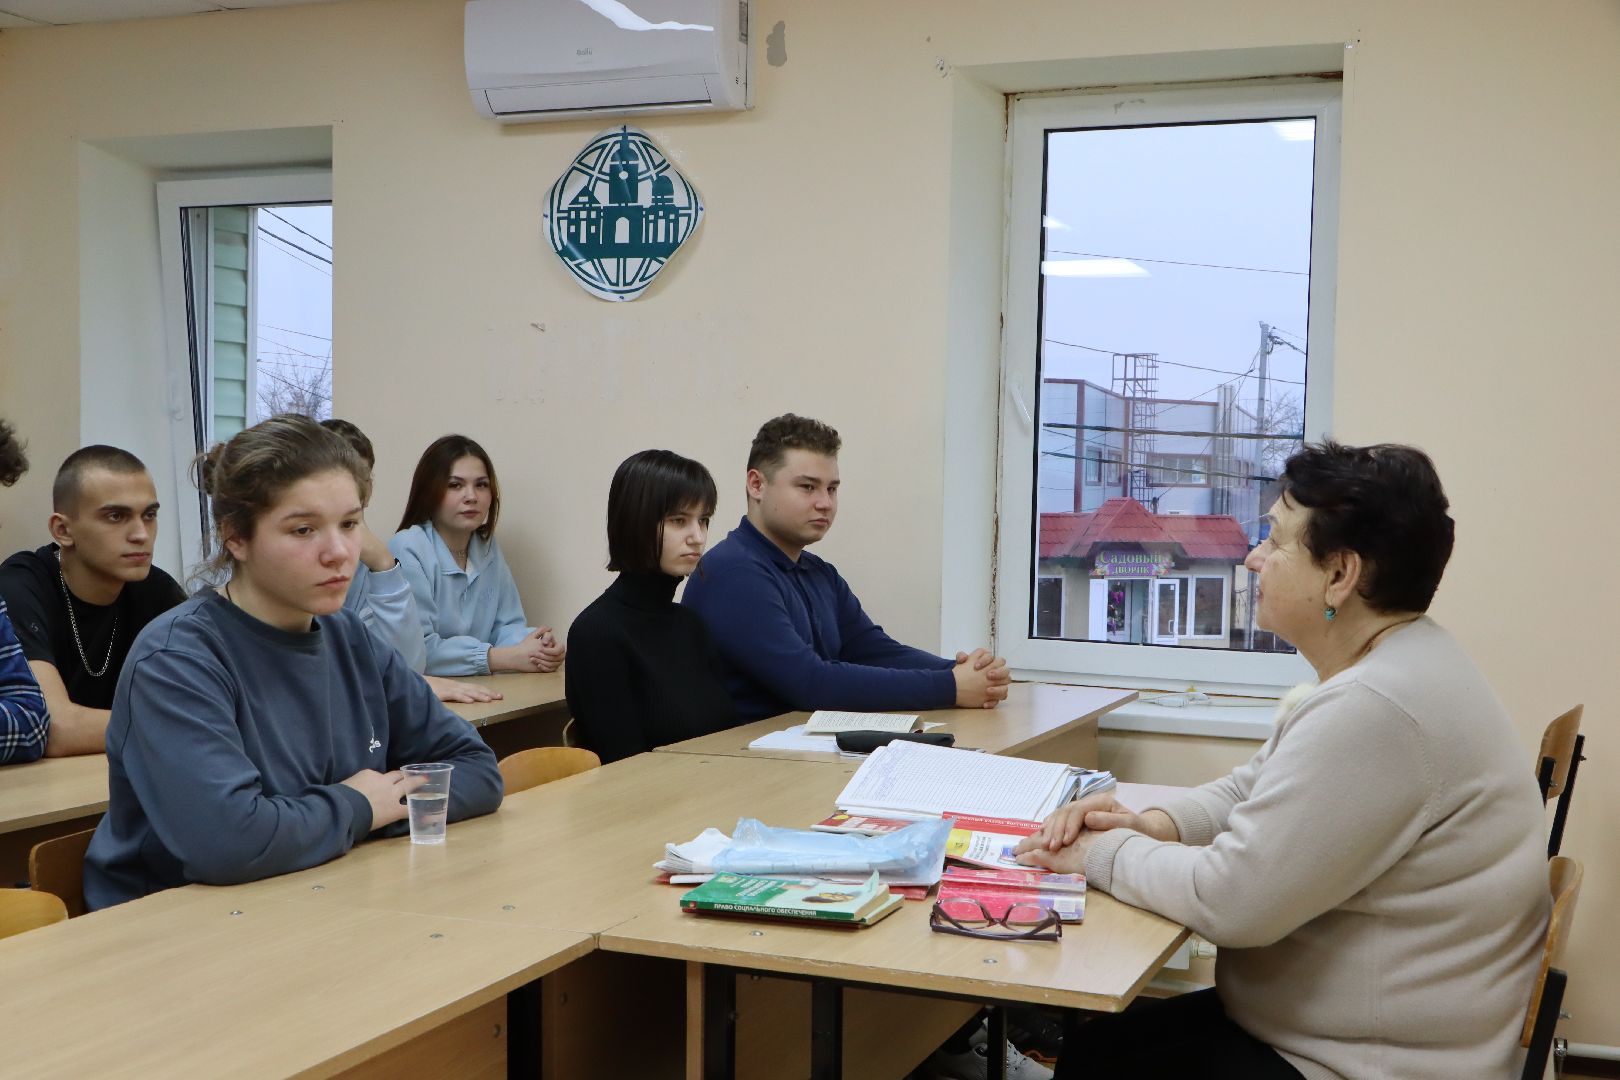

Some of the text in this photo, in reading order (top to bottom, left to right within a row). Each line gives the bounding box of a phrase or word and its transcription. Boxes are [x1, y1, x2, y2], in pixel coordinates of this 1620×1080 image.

[1100, 551, 1161, 564] Садовый
[734, 904, 776, 913] СОЦИАЛЬНОГО
[776, 907, 817, 916] ОБЕСПЕЧЕНИЯ
